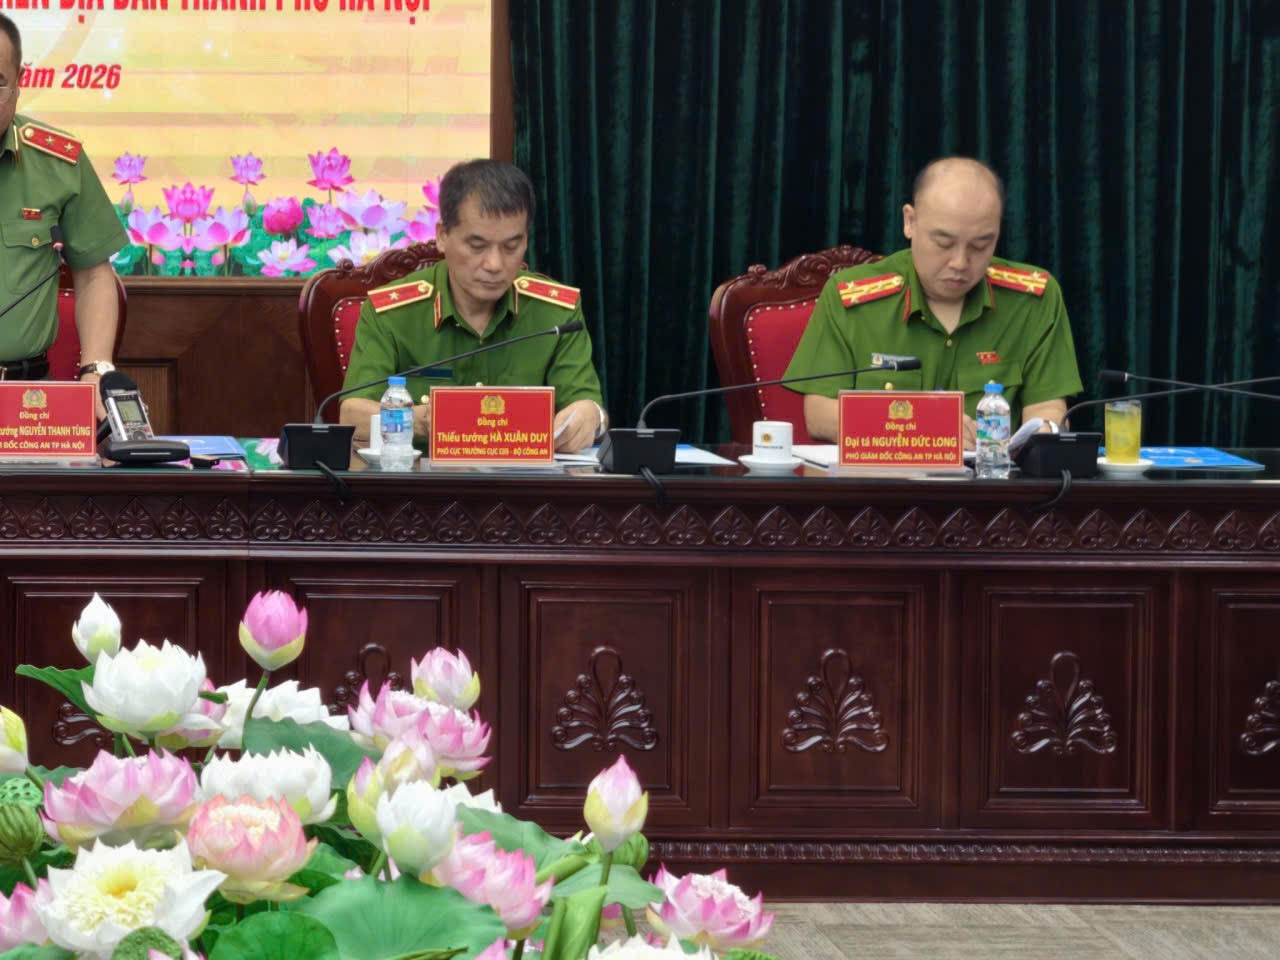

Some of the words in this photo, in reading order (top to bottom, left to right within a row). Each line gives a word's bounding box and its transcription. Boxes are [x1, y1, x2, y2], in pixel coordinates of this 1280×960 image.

[20, 63, 54, 88] ăm
[61, 64, 122, 89] 2026
[48, 426, 70, 435] THANH
[530, 433, 548, 442] DUY
[933, 437, 957, 447] LONG
